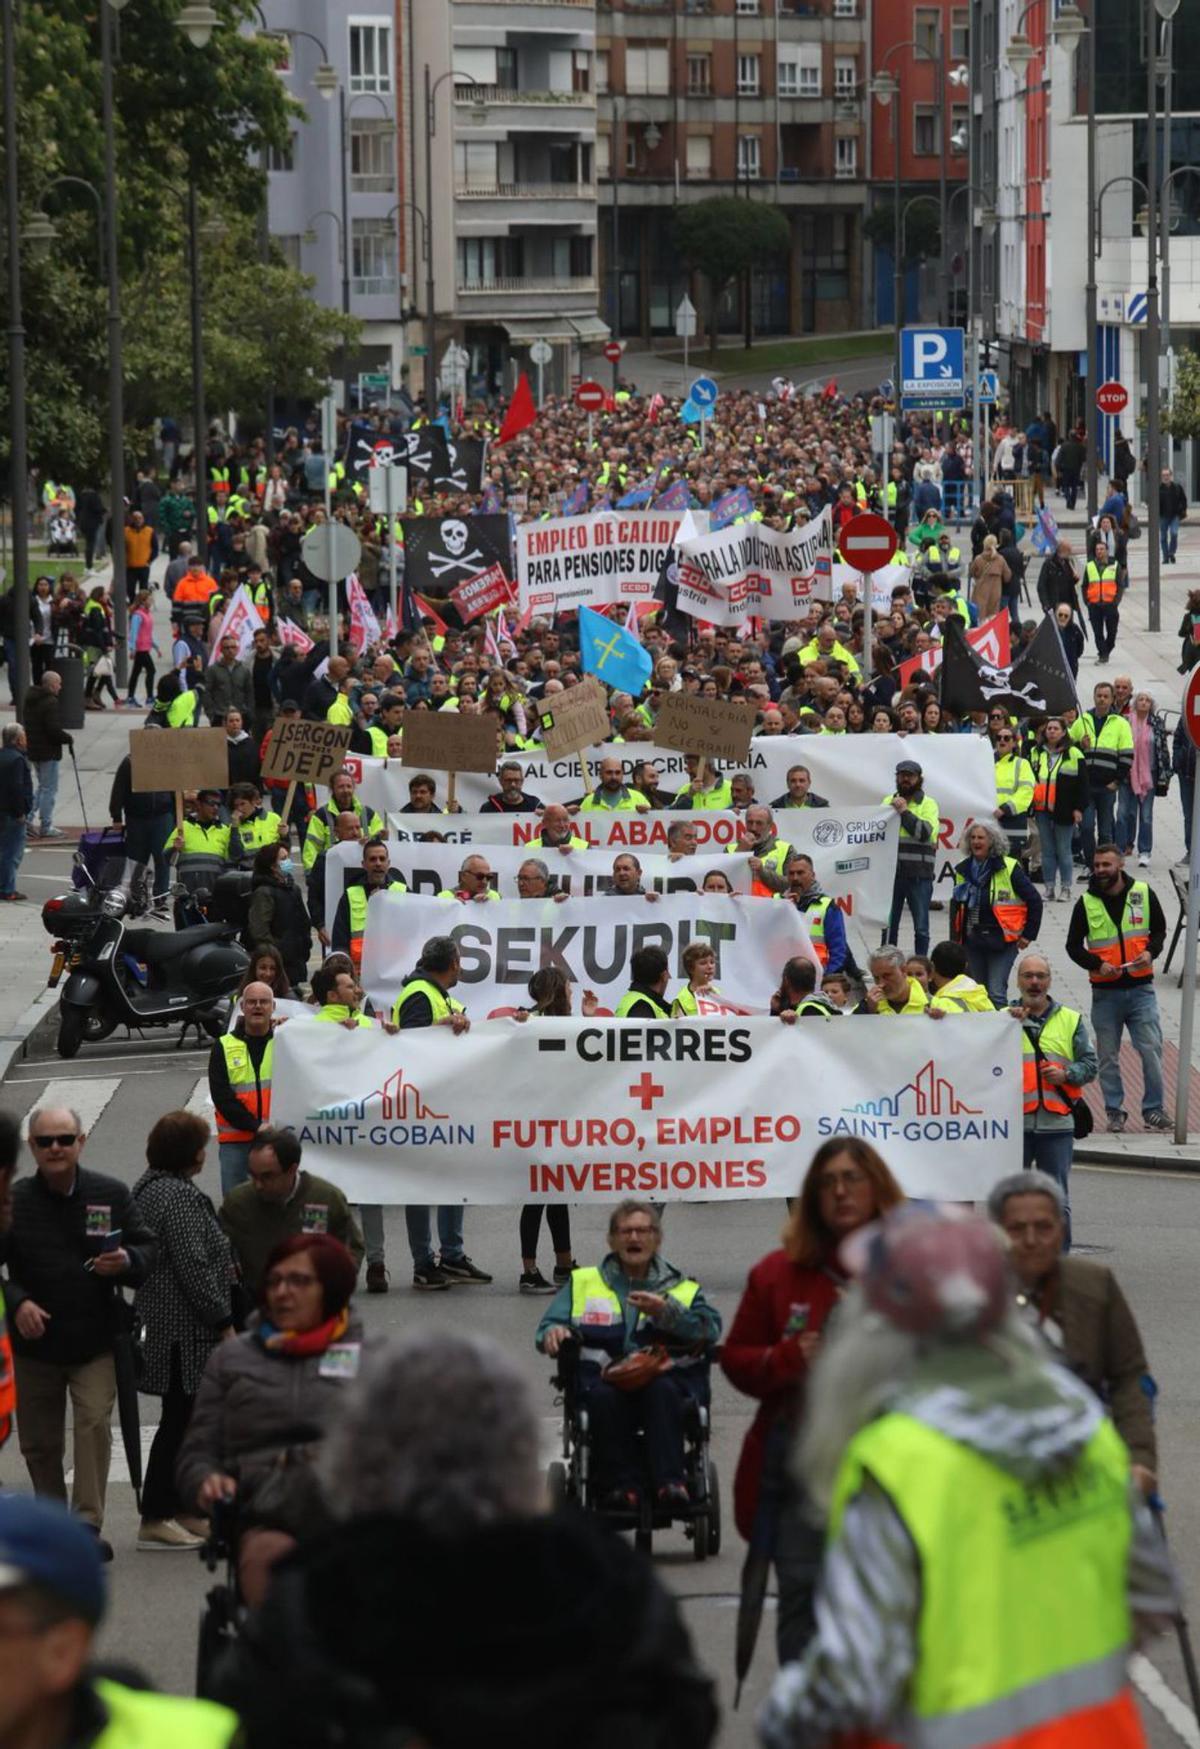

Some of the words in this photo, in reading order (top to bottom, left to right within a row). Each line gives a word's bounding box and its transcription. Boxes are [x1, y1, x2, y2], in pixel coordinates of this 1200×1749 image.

[913, 333, 948, 378] P
[1100, 394, 1126, 403] STOP
[528, 525, 587, 556] EMPLEO
[594, 522, 613, 546] DE
[528, 557, 561, 586] PARA
[565, 548, 635, 580] PENSIONES
[286, 723, 349, 748] SERGON
[670, 716, 688, 731] NO
[283, 751, 334, 777] DEP
[525, 763, 548, 778] AL
[846, 820, 887, 833] GRUPO
[847, 832, 886, 844] EULEN
[576, 1028, 752, 1062] CIERRES
[493, 1118, 646, 1151] FUTURO,
[656, 1115, 801, 1146] EMPLEO
[818, 1116, 1009, 1141] SAINT-GOBAIN
[530, 1160, 767, 1192] INVERSIONES
